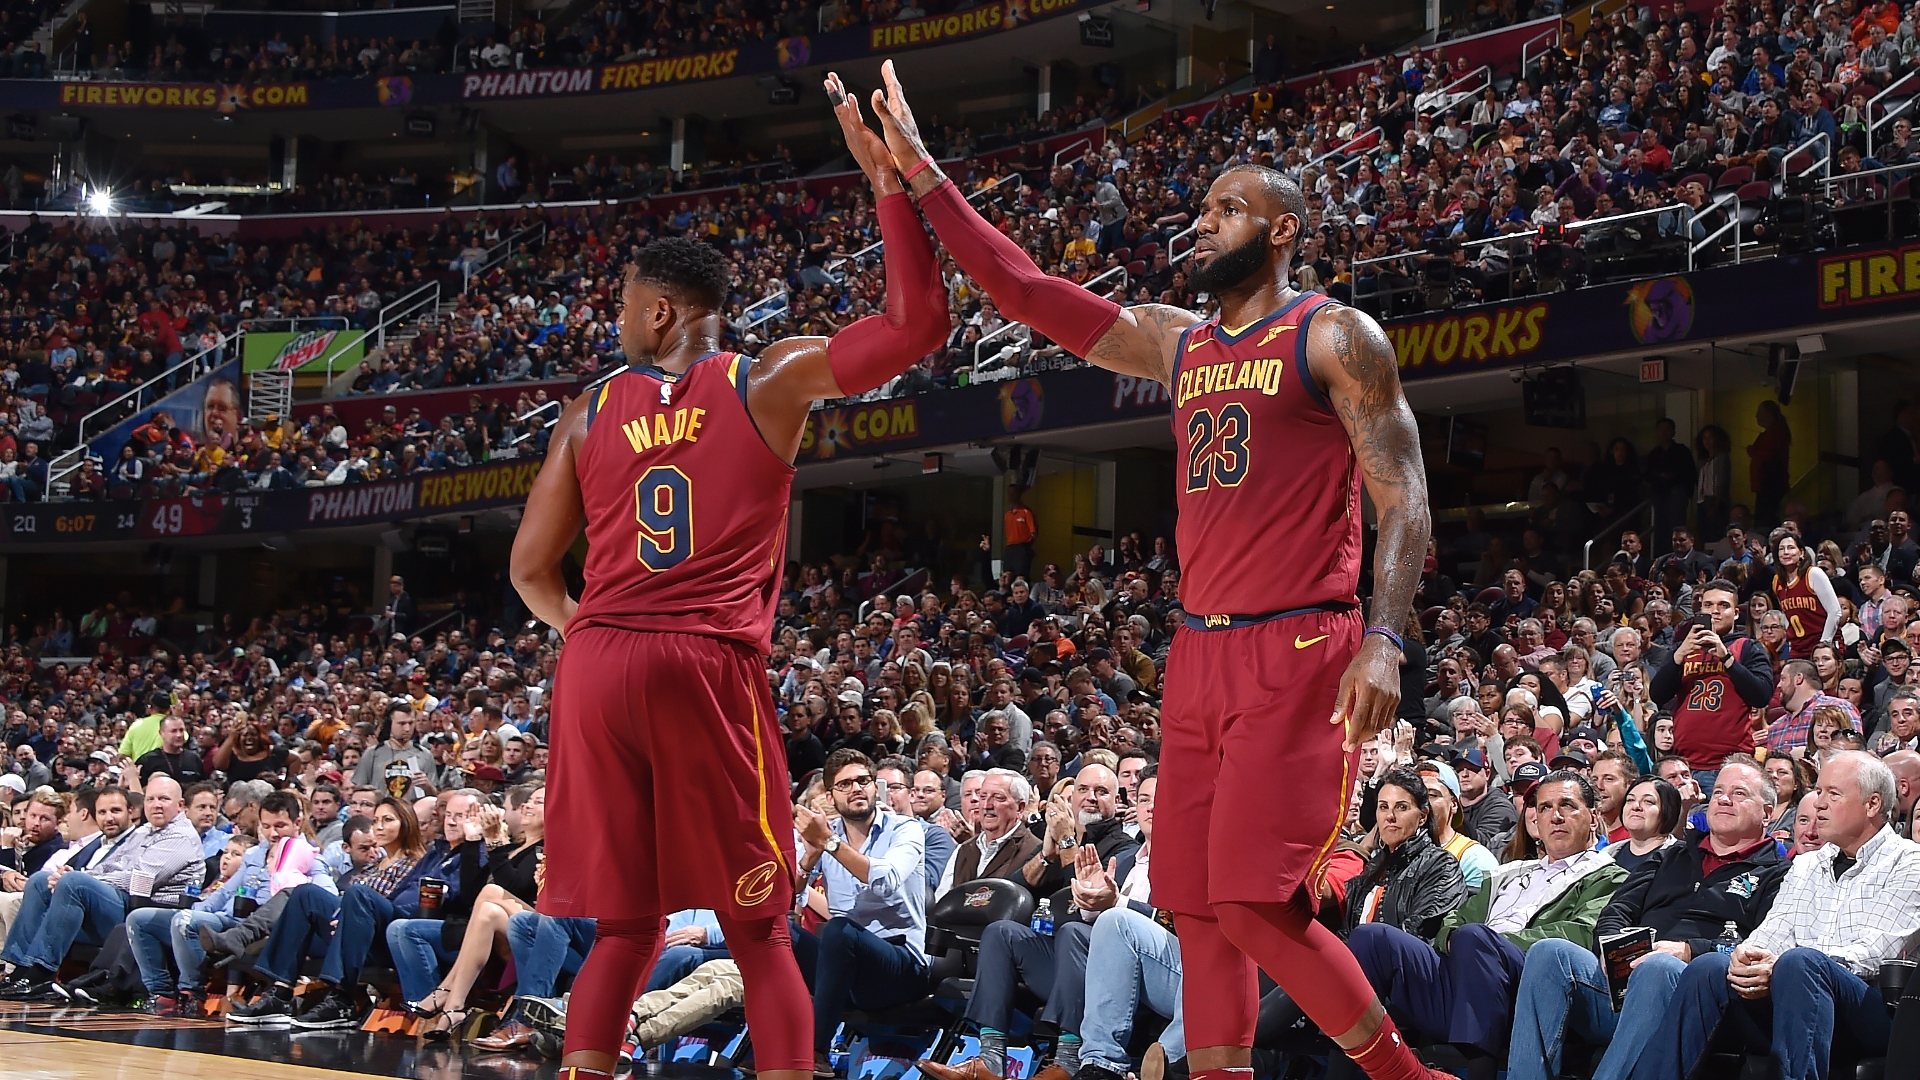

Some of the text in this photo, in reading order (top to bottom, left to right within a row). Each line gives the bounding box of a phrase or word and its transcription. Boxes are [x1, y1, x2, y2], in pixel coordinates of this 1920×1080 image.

[872, 0, 1077, 48] FIREWORKS CO
[463, 49, 739, 98] PHANTOM FIREWORKS
[63, 85, 308, 106] FIREWORKS COM
[1178, 358, 1284, 409] CLEVELAND
[622, 407, 706, 454] WADE
[853, 404, 915, 440] COM
[1186, 402, 1251, 494] 23
[308, 461, 541, 521] PHANTOM FIREWORKS
[55, 514, 96, 532] 6:07
[117, 513, 135, 529] 24
[152, 504, 183, 533] 49
[241, 507, 252, 529] 3
[635, 464, 694, 573] 9
[1790, 614, 1805, 638] 0
[1687, 679, 1725, 712] 23
